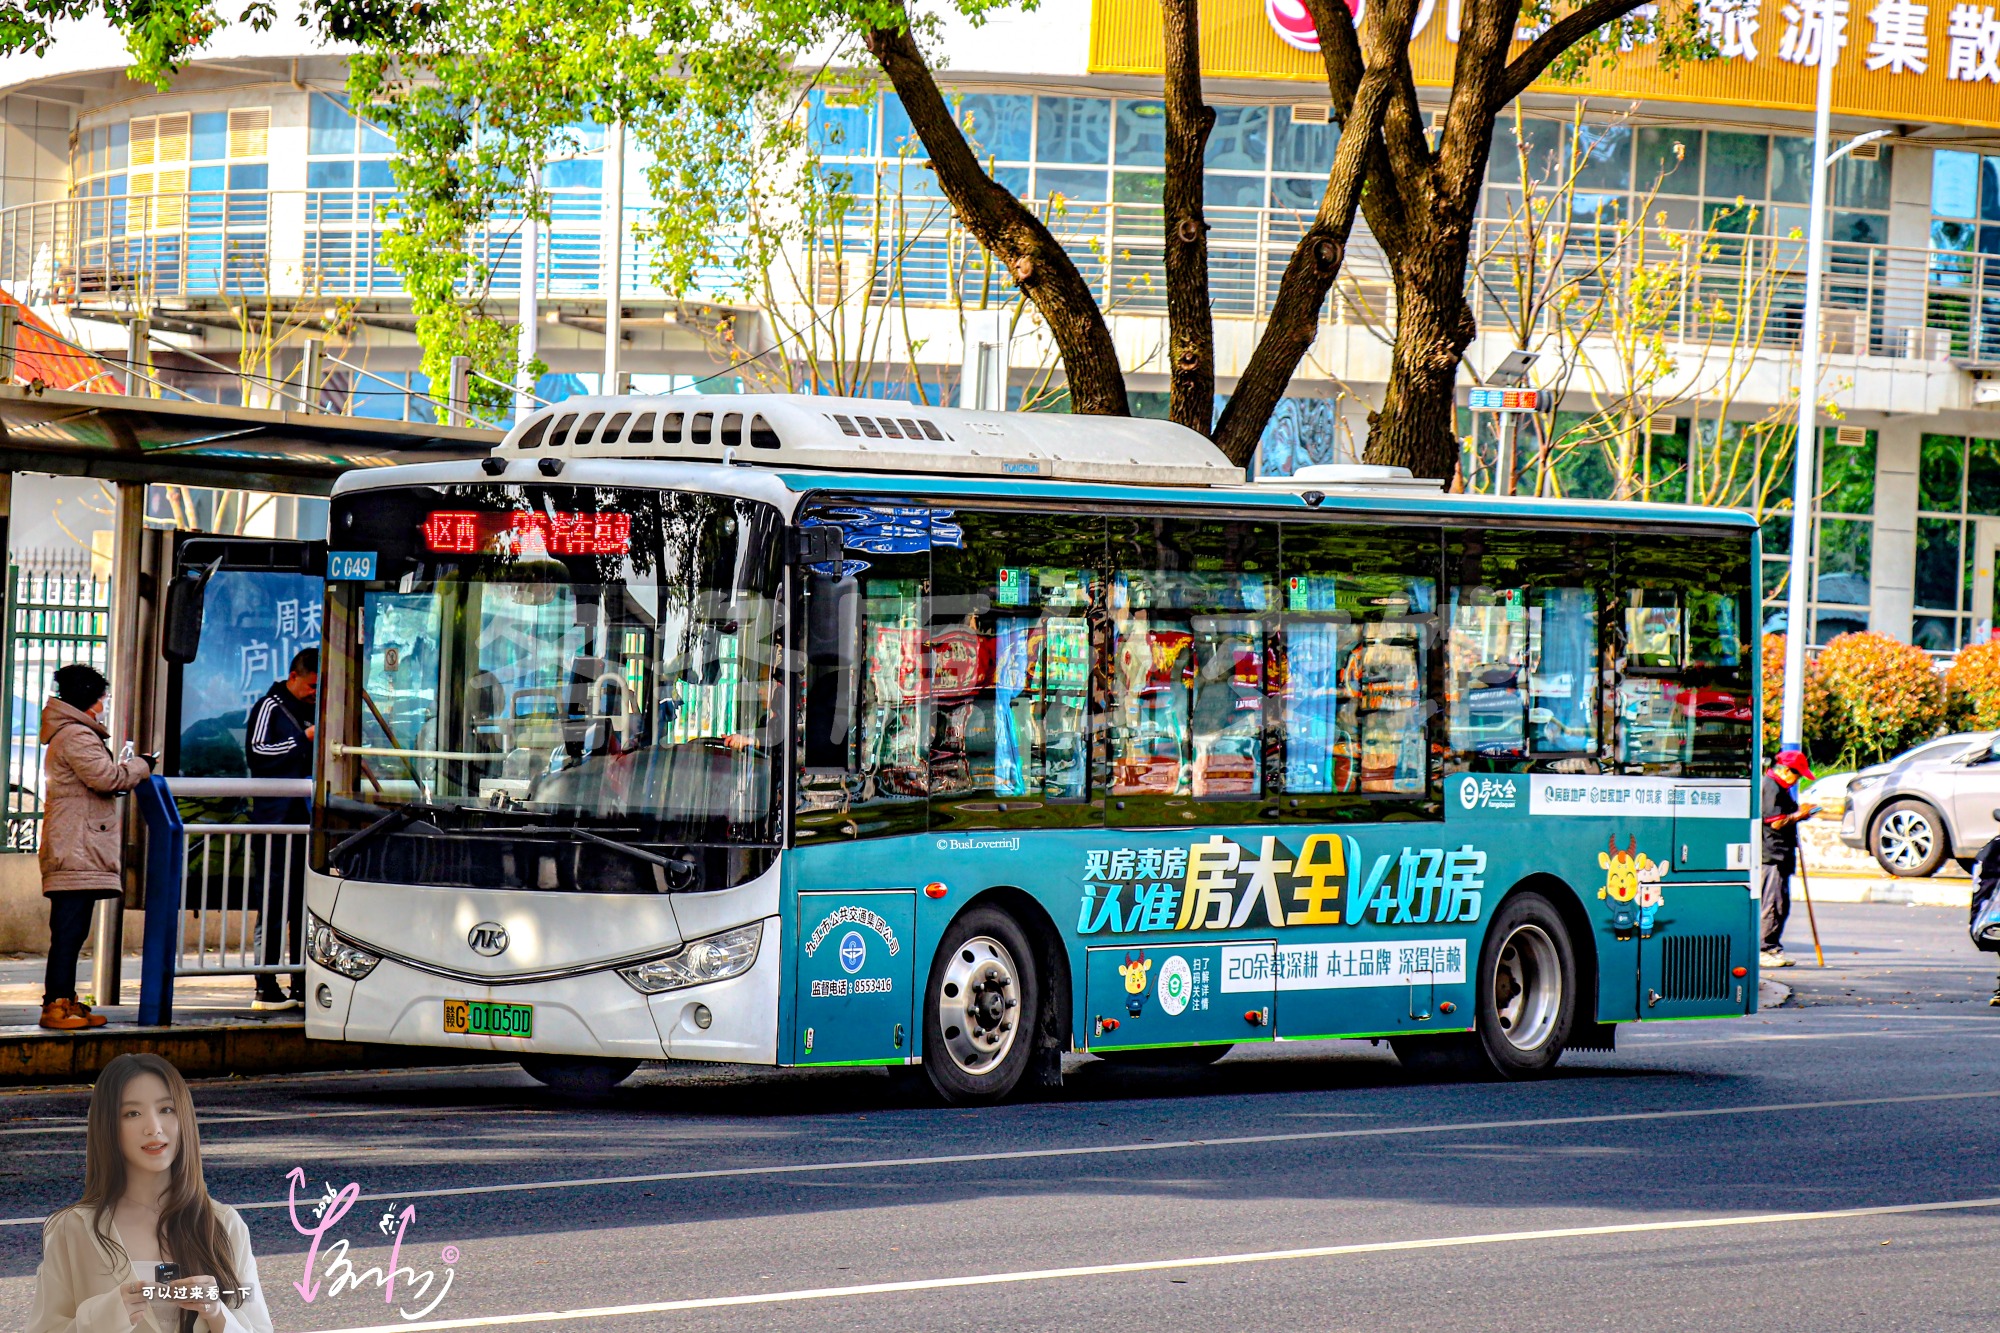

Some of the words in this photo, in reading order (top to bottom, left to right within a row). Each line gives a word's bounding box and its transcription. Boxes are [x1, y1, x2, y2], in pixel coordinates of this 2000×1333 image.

[331, 556, 341, 577] C
[344, 557, 371, 578] 049
[275, 598, 322, 639] 周末
[241, 637, 320, 691] 庐山
[1479, 778, 1517, 808] 房大全
[1076, 883, 1182, 934] 认准
[1174, 833, 1347, 931] 房大全
[1082, 847, 1188, 882] 买房卖房
[804, 905, 900, 957] 九江市公共交通集团公司
[1229, 950, 1319, 981] 20余载深耕
[1326, 949, 1392, 979] 本土品牌
[1399, 946, 1461, 974] 深得信赖
